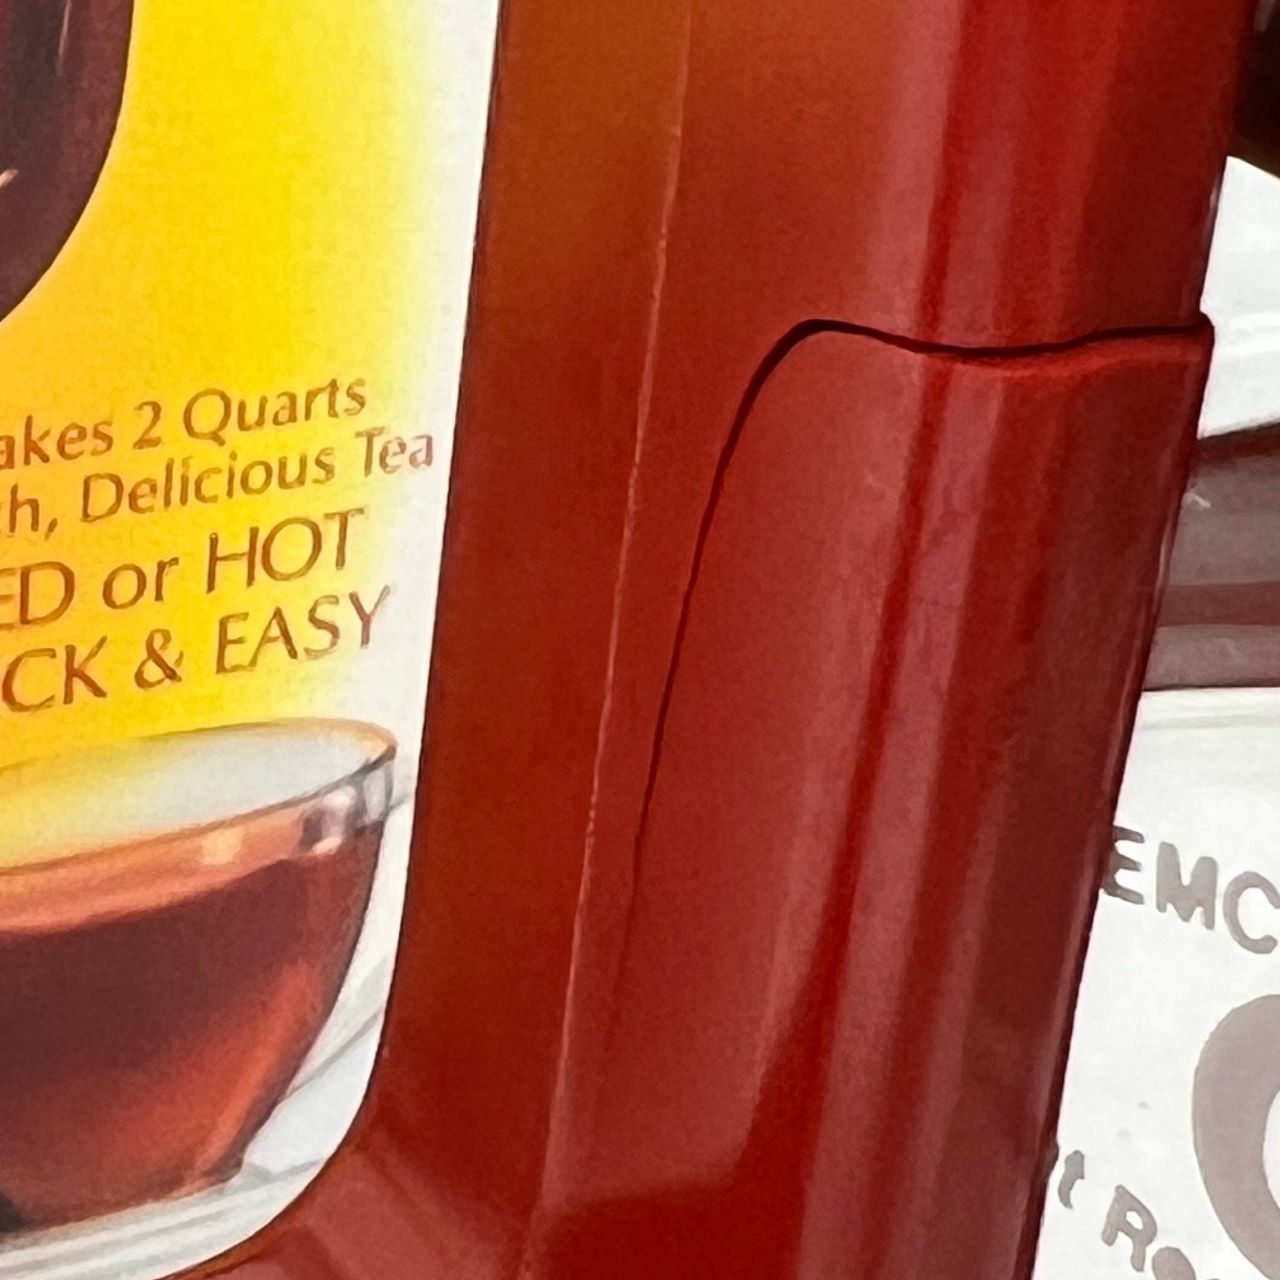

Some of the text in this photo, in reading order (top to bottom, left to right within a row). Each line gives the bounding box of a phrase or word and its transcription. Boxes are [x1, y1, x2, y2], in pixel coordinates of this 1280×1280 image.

[132, 401, 161, 450] 2
[182, 375, 367, 442] Quarts
[81, 447, 335, 523] Delicious
[356, 426, 433, 477] Tea
[102, 556, 178, 610] or
[206, 507, 364, 594] HOT
[133, 628, 184, 691] &
[216, 584, 391, 675] EASY
